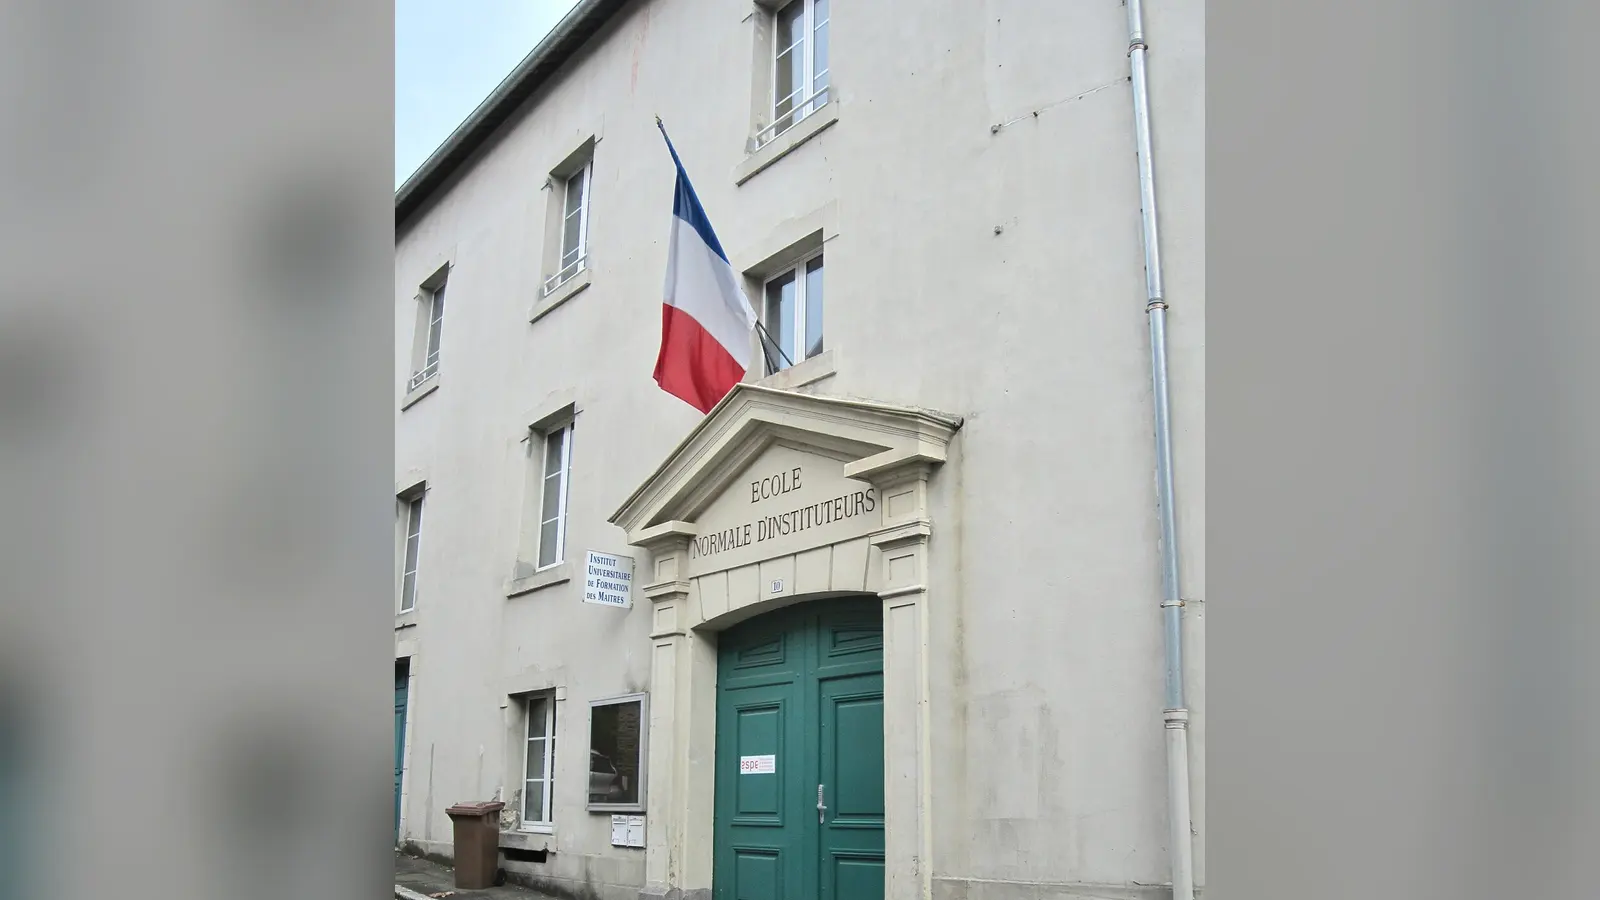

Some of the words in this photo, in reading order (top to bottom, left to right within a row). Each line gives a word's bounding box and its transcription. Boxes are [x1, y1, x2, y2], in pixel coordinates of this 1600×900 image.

[751, 467, 802, 503] ECOLE
[692, 523, 752, 559] NORMALE
[757, 488, 876, 542] D'INSTITUTEURS
